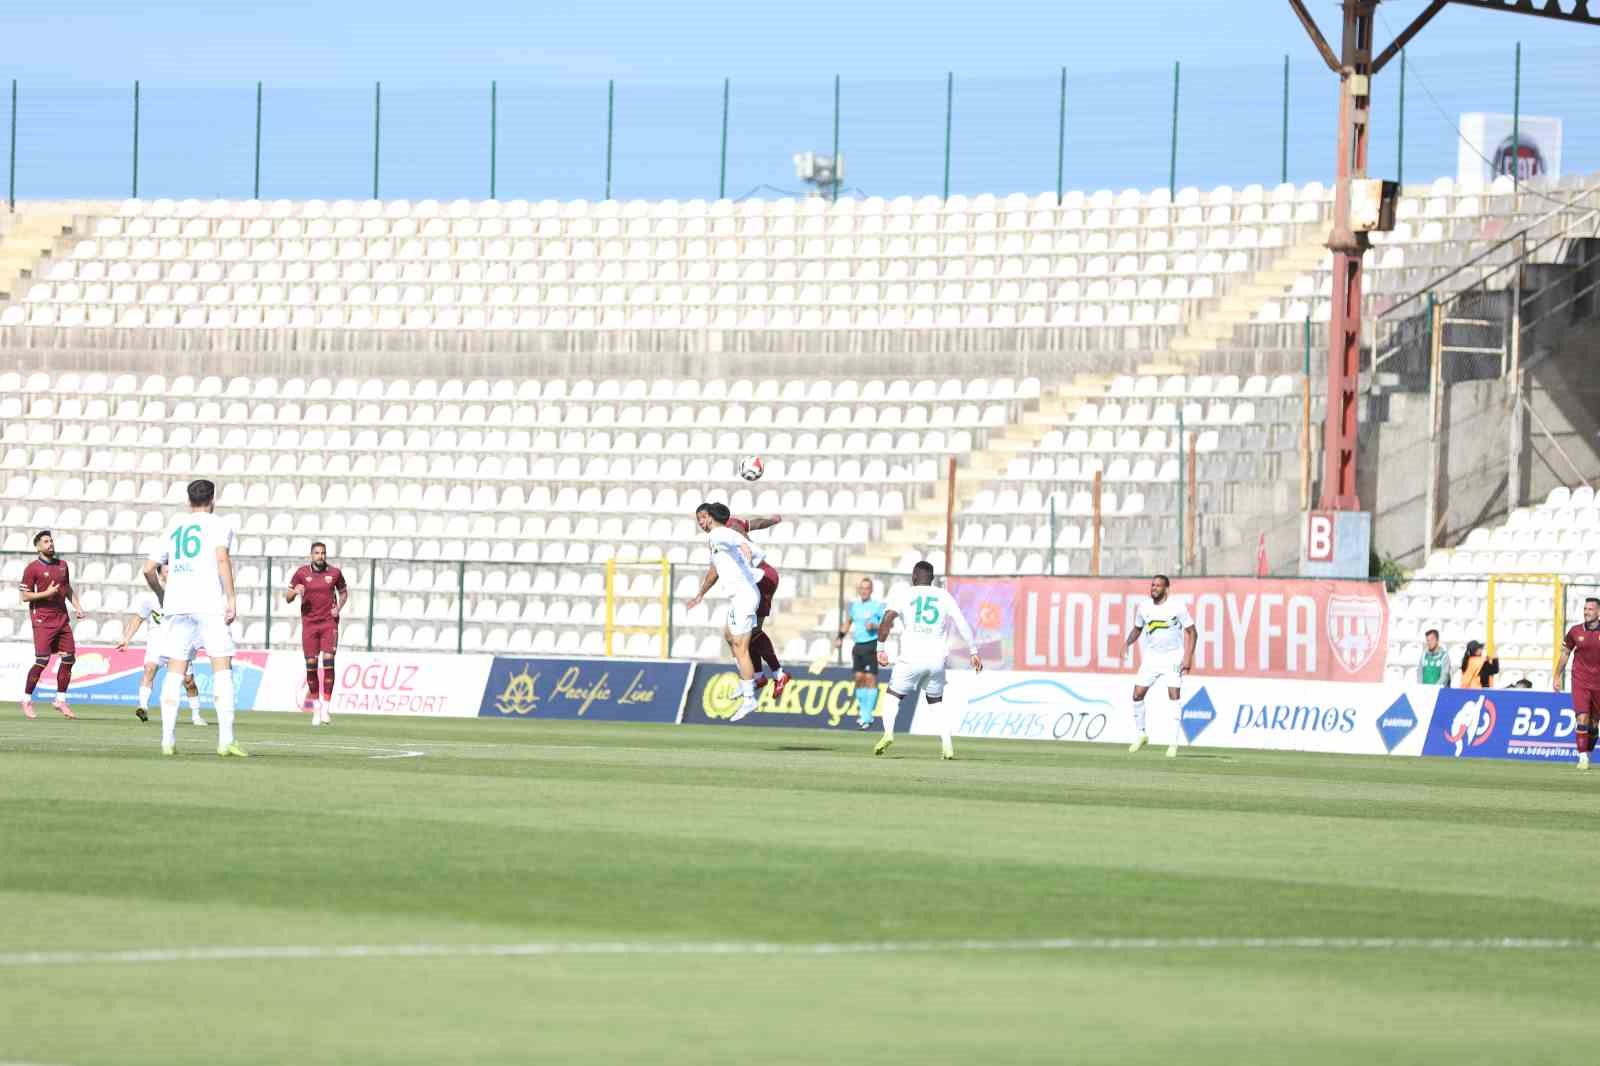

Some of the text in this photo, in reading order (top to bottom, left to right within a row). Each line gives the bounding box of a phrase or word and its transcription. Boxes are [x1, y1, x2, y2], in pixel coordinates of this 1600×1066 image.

[170, 524, 201, 560] 16
[1311, 516, 1331, 558] B
[910, 596, 939, 624] 15
[337, 693, 448, 713] TRANSPORT
[549, 666, 657, 716] Pacific Line
[959, 711, 1107, 740] KAFKAS OTO
[1233, 704, 1357, 734] PARMOS
[1511, 706, 1550, 736] BD
